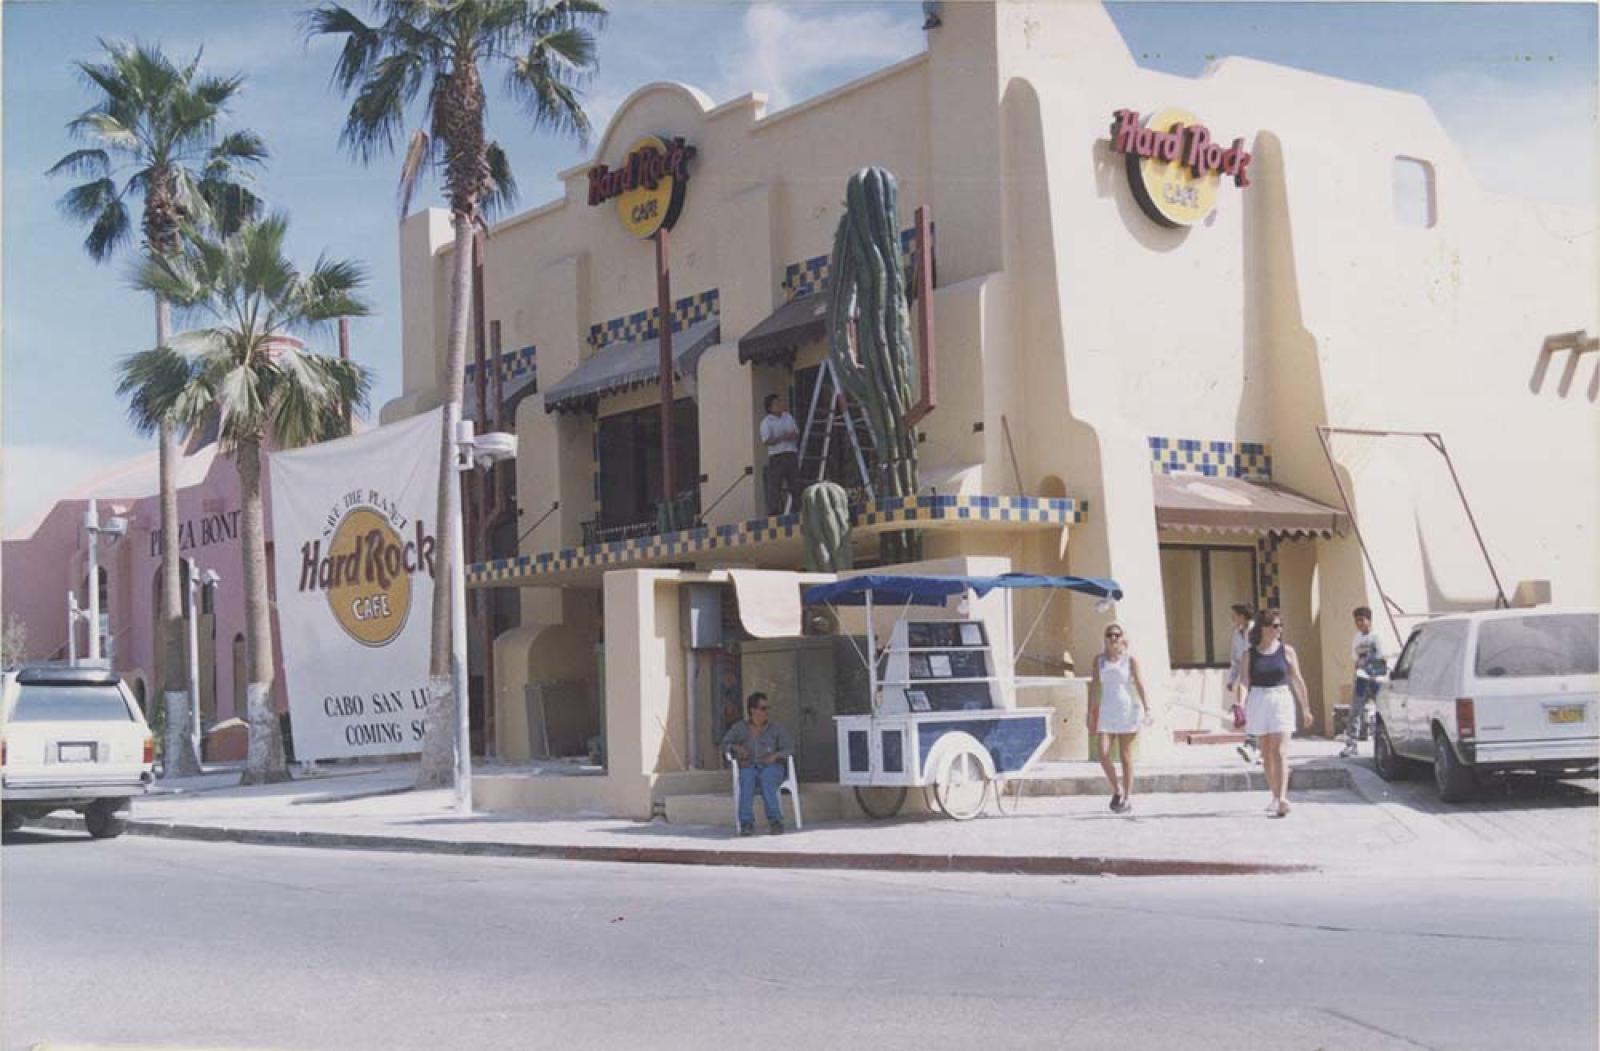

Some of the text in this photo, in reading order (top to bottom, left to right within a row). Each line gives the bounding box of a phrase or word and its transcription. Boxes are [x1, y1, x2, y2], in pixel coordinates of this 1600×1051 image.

[1111, 108, 1251, 188] Hard Rock
[588, 136, 696, 206] Hard Rock
[1163, 182, 1200, 209] CAFE
[343, 488, 363, 508] THE
[298, 519, 436, 592] Hard Rock
[351, 593, 392, 621] CAFE
[324, 686, 432, 717] CABO SAN LU
[345, 722, 403, 746] COMING
